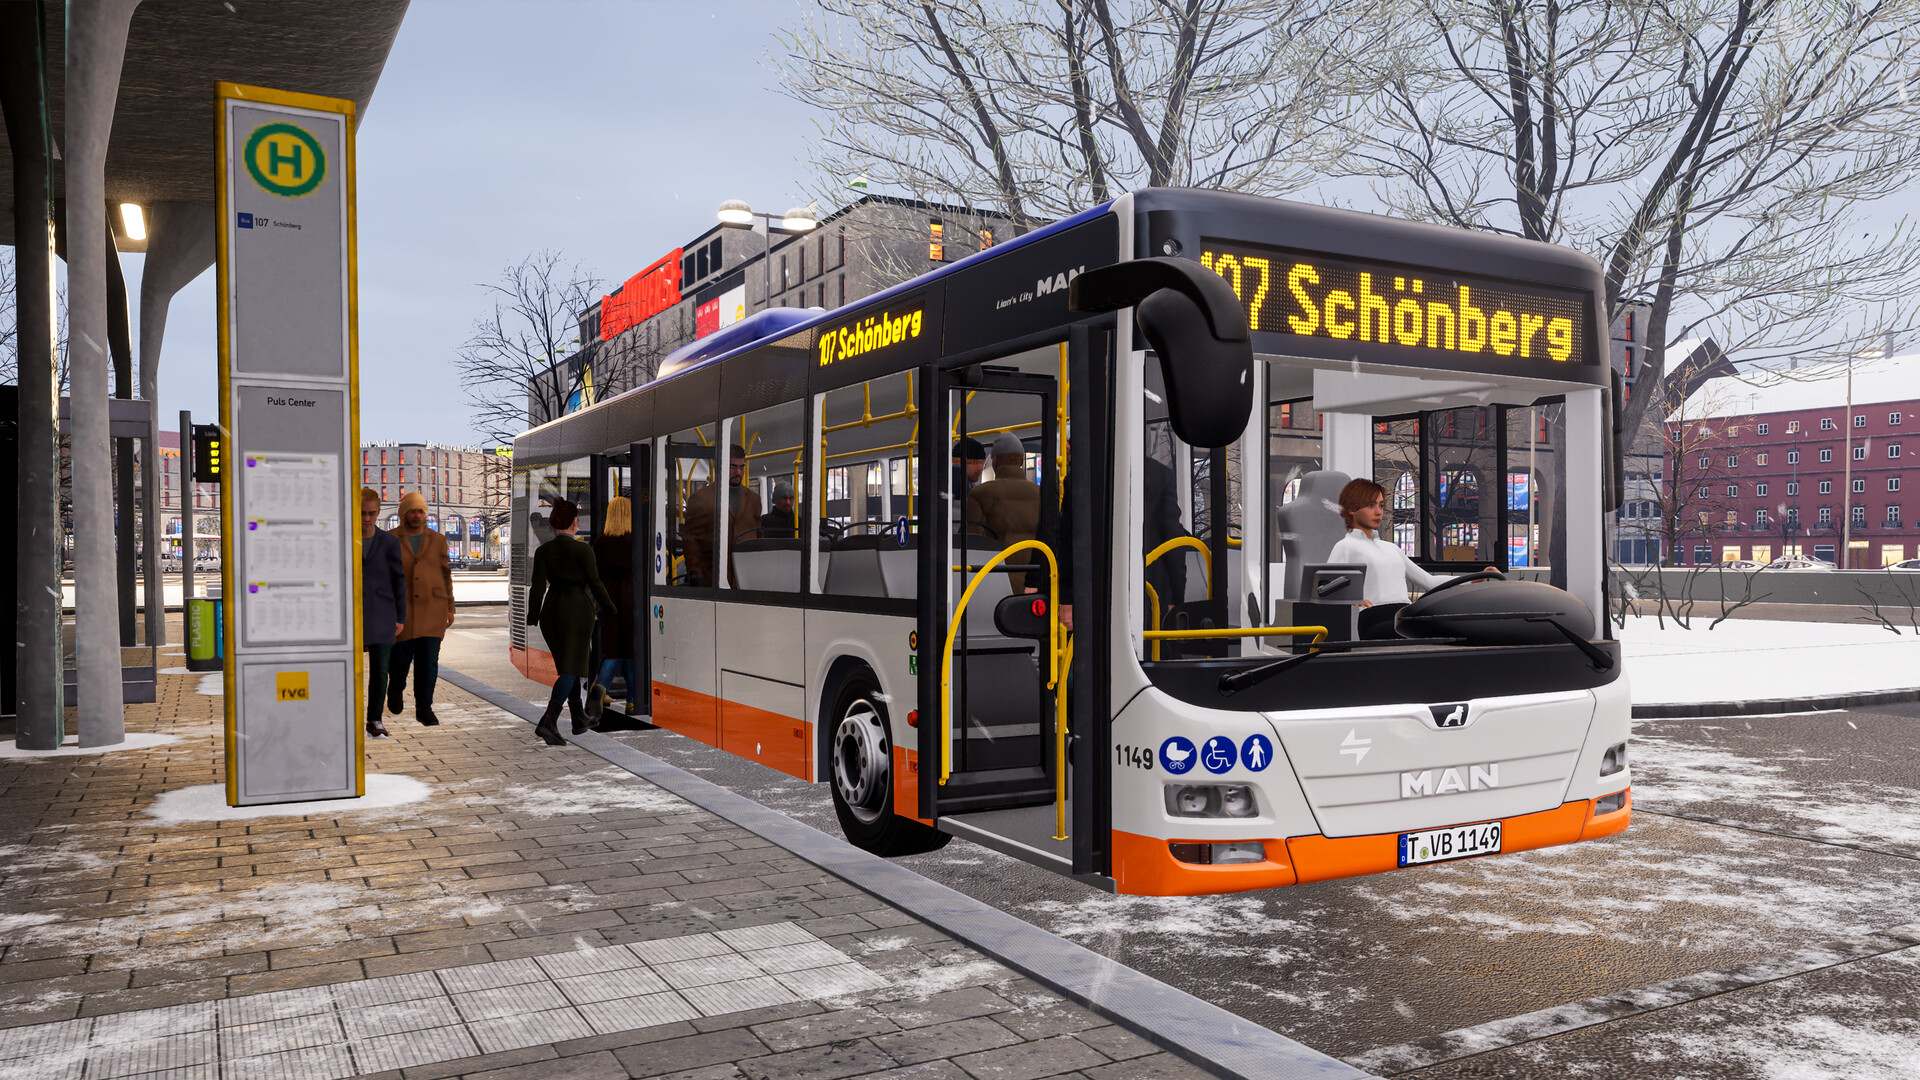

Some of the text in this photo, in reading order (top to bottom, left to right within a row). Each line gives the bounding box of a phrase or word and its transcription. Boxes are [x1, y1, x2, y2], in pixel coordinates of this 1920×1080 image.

[269, 142, 302, 179] H
[255, 217, 301, 230] 107 Schönberg
[996, 296, 1017, 310] Lion's
[1019, 291, 1034, 303] City
[1201, 251, 1573, 362] 07 Schönberg
[819, 309, 922, 367] 107 Schönberg
[267, 396, 316, 408] Puls Center
[191, 605, 200, 647] PLASTIC
[1115, 744, 1154, 770] 1149
[1401, 763, 1499, 799] MAN
[1408, 826, 1500, 860] T VB 1149
